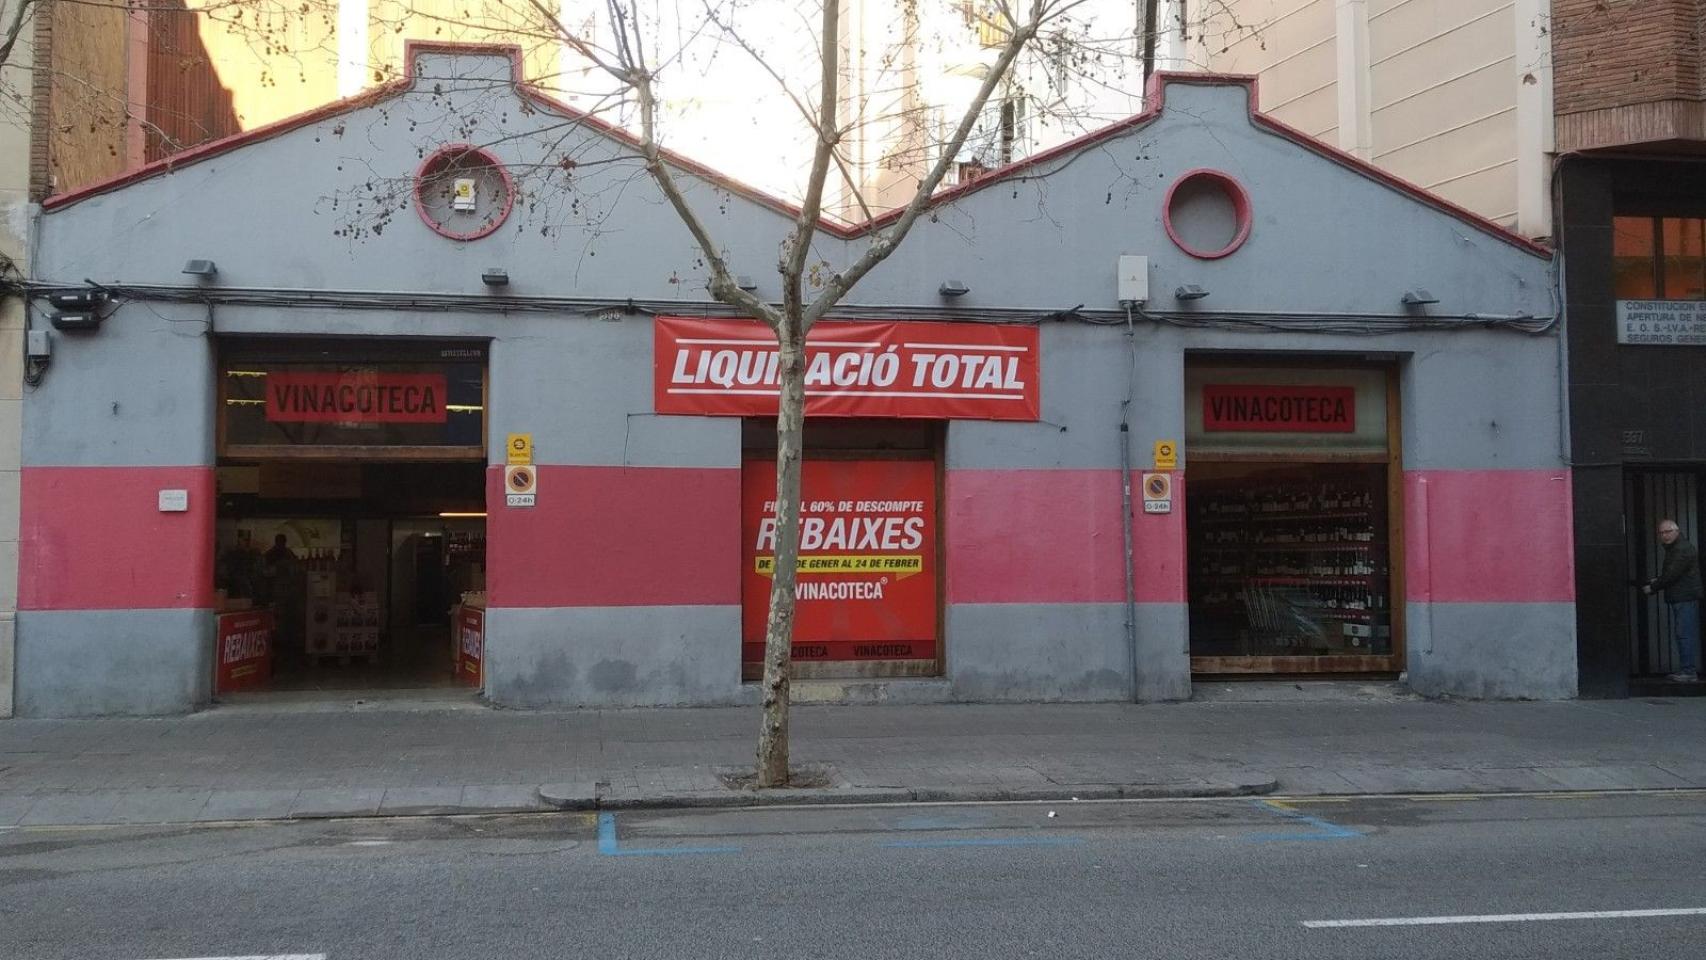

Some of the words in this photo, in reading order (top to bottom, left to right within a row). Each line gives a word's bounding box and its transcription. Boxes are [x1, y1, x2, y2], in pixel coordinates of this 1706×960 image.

[1627, 312, 1675, 321] APERTURA
[1680, 313, 1692, 321] DE
[1626, 335, 1673, 343] SEGUROS
[671, 345, 900, 389] LIQUIACIÓ
[911, 353, 1025, 390] TOTAL
[273, 384, 437, 414] VINACOTECA
[1210, 396, 1347, 423] VINACOTECA
[810, 501, 835, 512] 60%
[838, 501, 853, 512] DE
[855, 501, 924, 512] DESCOMPTE
[755, 516, 925, 551] RBAIXES
[758, 559, 771, 569] DE
[809, 559, 839, 569] GENER
[841, 559, 852, 568] AL
[855, 559, 867, 568] 24
[870, 559, 881, 568] DE
[884, 559, 919, 568] FEBRER
[854, 645, 913, 657] VINACOTECA
